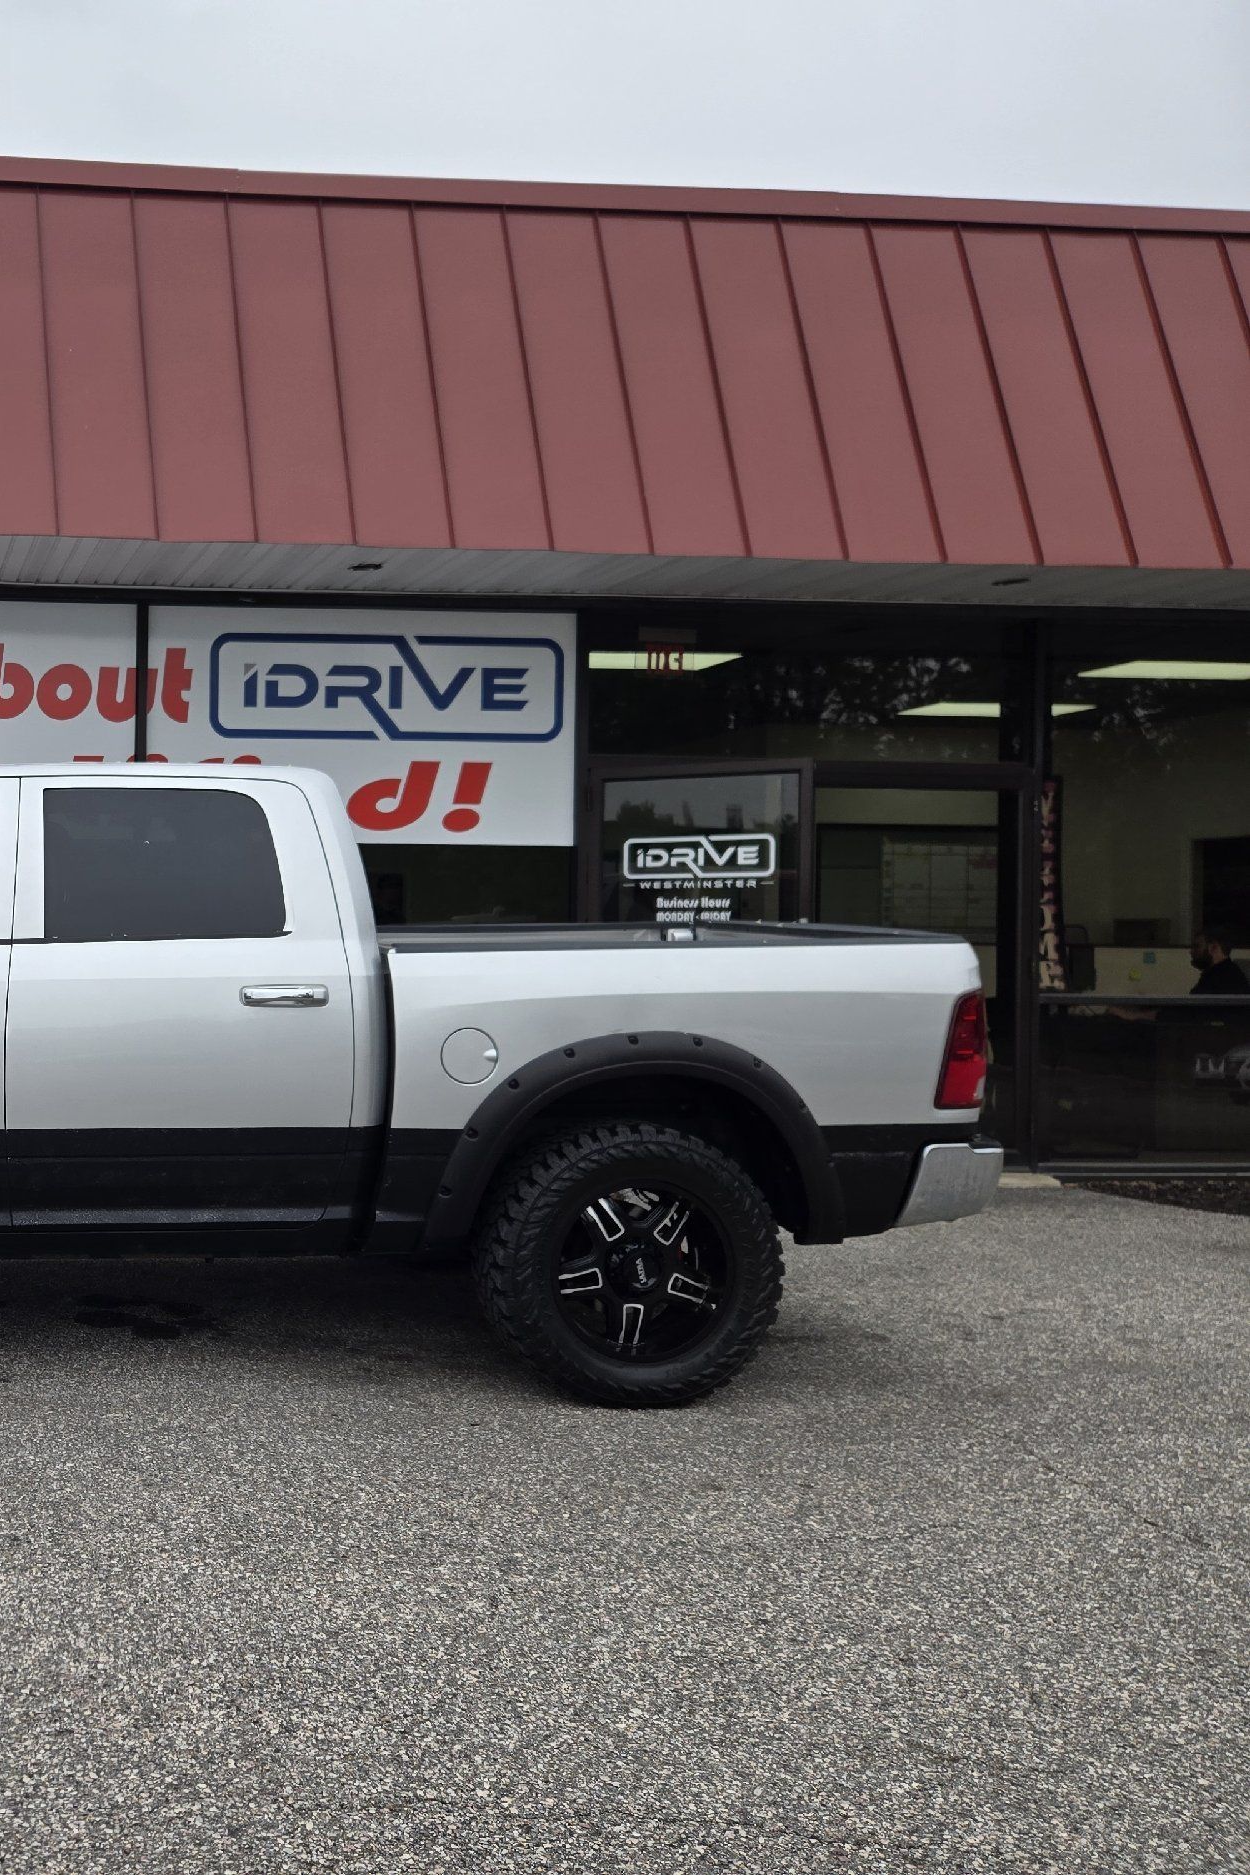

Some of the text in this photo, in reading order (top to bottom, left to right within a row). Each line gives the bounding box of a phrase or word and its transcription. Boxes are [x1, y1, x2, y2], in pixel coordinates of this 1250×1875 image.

[639, 879, 757, 889] WESTMINSTER
[656, 896, 731, 909] Business Hours
[656, 911, 695, 922] MONDAY
